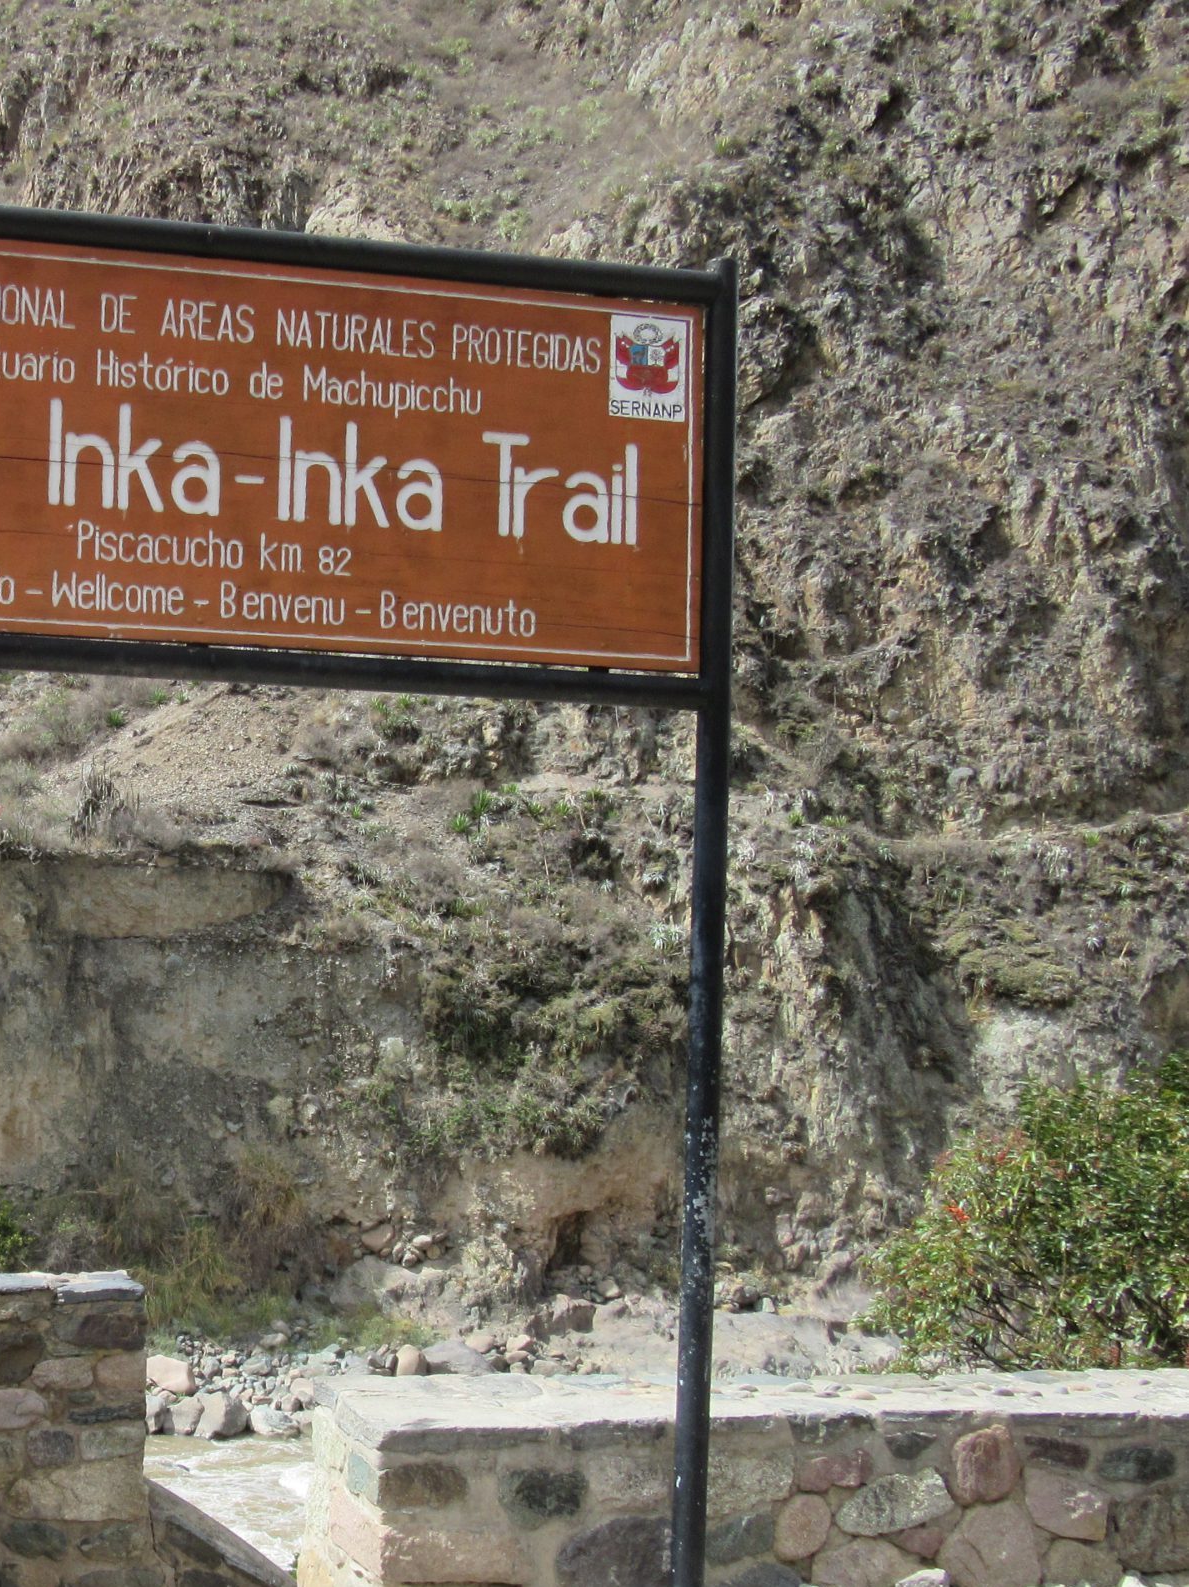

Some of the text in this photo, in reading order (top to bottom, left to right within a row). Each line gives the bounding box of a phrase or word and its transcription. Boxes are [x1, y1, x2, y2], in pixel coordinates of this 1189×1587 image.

[100, 292, 137, 334] DE
[160, 298, 255, 343] AREAS
[276, 307, 436, 359] NATURALES
[451, 323, 601, 374] PROTEGIDAS
[96, 348, 229, 396] Histórico
[249, 362, 284, 400] de
[302, 364, 482, 418] Machupicchu
[610, 399, 683, 418] SERNANP
[47, 397, 220, 517] Inka
[277, 415, 443, 532] Inka
[482, 431, 638, 546] Trail
[76, 518, 244, 570] Piscacucho
[318, 546, 352, 577] 82
[51, 569, 185, 616] Wellcome
[219, 580, 345, 626] Benvenu
[379, 590, 537, 638] Benvenuto
